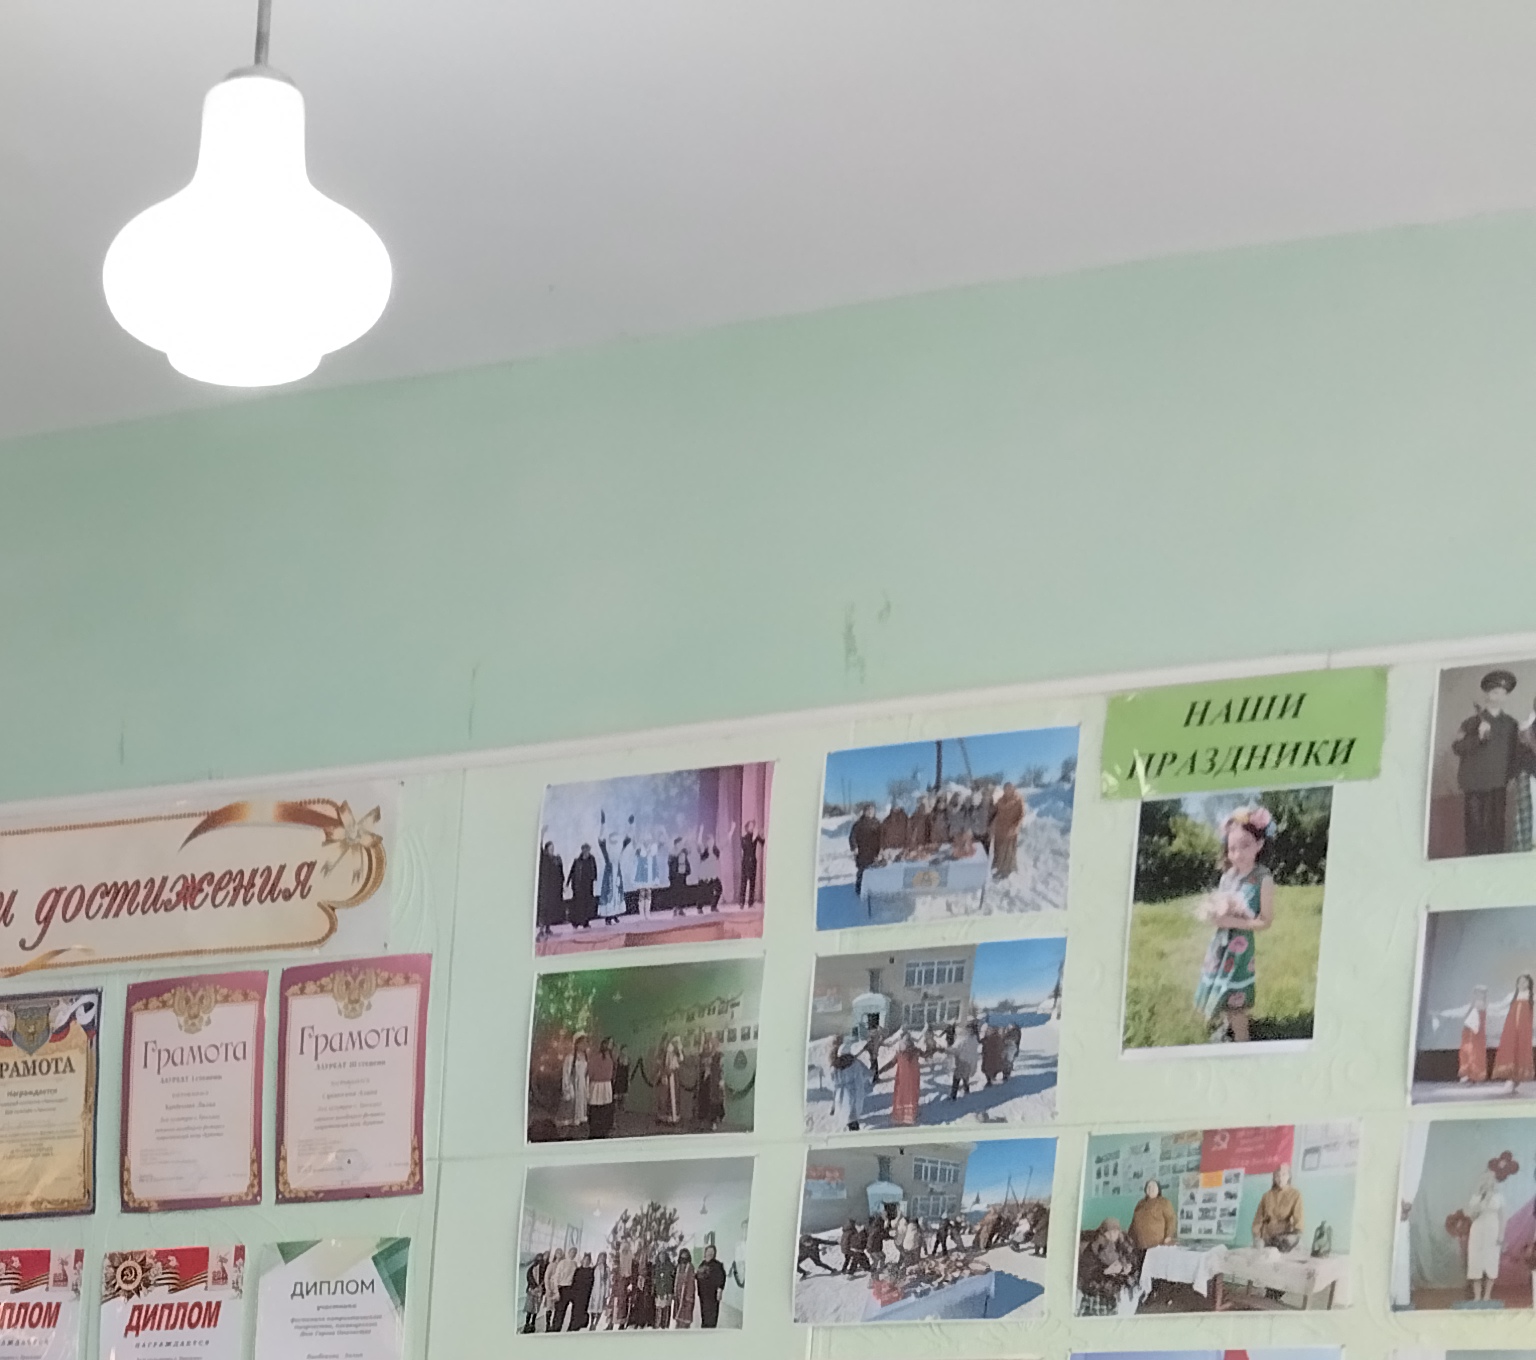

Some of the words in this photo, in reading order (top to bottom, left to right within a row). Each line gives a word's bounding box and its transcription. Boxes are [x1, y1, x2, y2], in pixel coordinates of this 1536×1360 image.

[1183, 692, 1307, 727] НАШИ
[1127, 737, 1357, 780] ПРАЗДНИКИ
[19, 857, 319, 952] достижения
[143, 1040, 248, 1075] Грамота
[299, 1025, 409, 1062] Грамота
[290, 1279, 375, 1300] ДИПЛОМ
[124, 1300, 222, 1338] ДИПЛОМ
